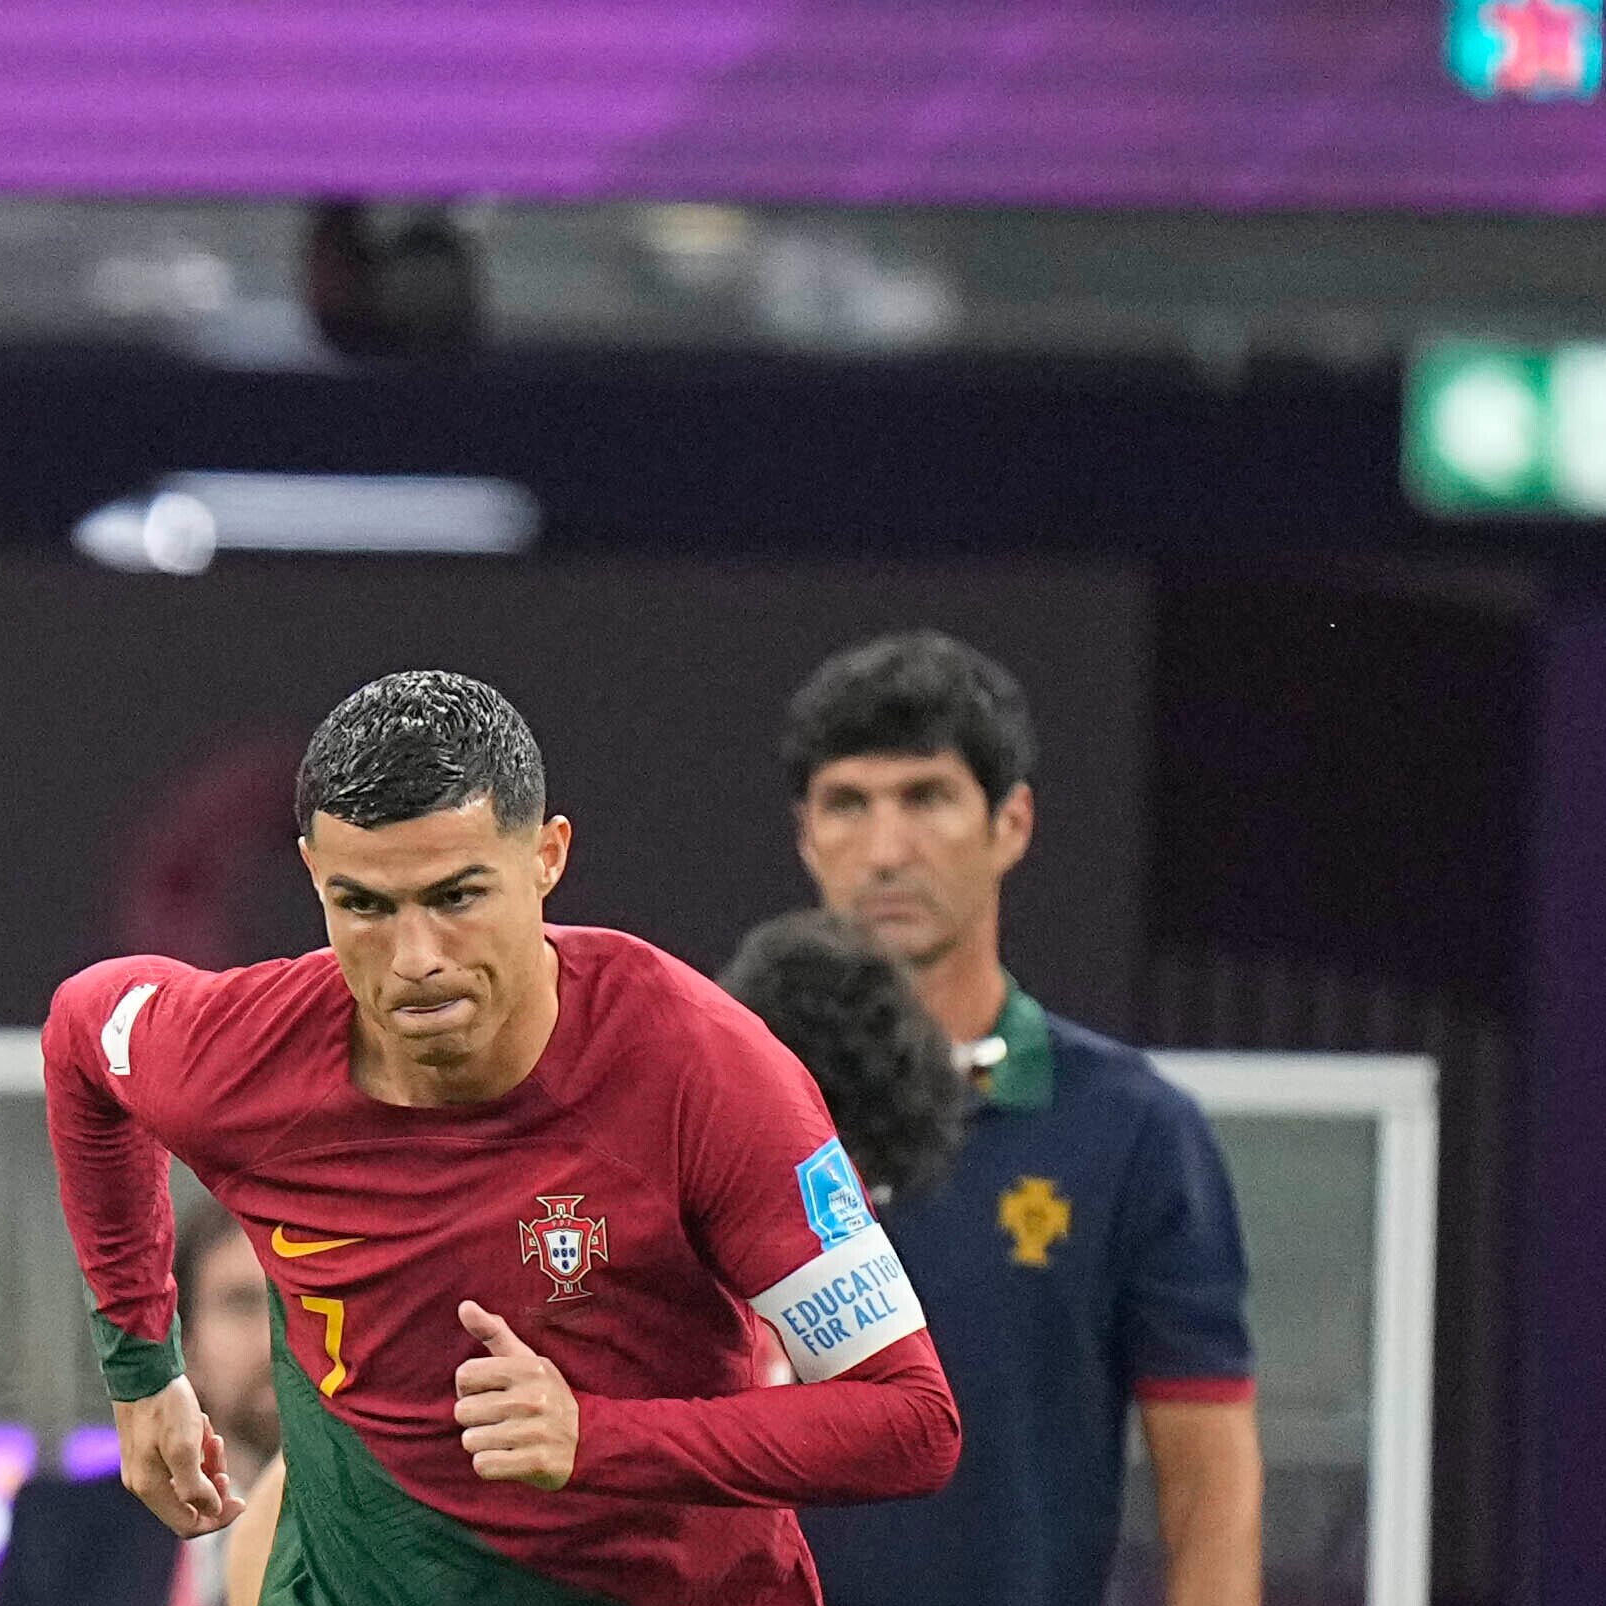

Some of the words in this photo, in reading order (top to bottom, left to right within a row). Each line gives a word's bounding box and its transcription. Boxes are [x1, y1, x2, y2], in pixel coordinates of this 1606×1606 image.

[299, 1295, 347, 1400] 7
[801, 1318, 851, 1356] FOR
[853, 1290, 898, 1330] ALL
